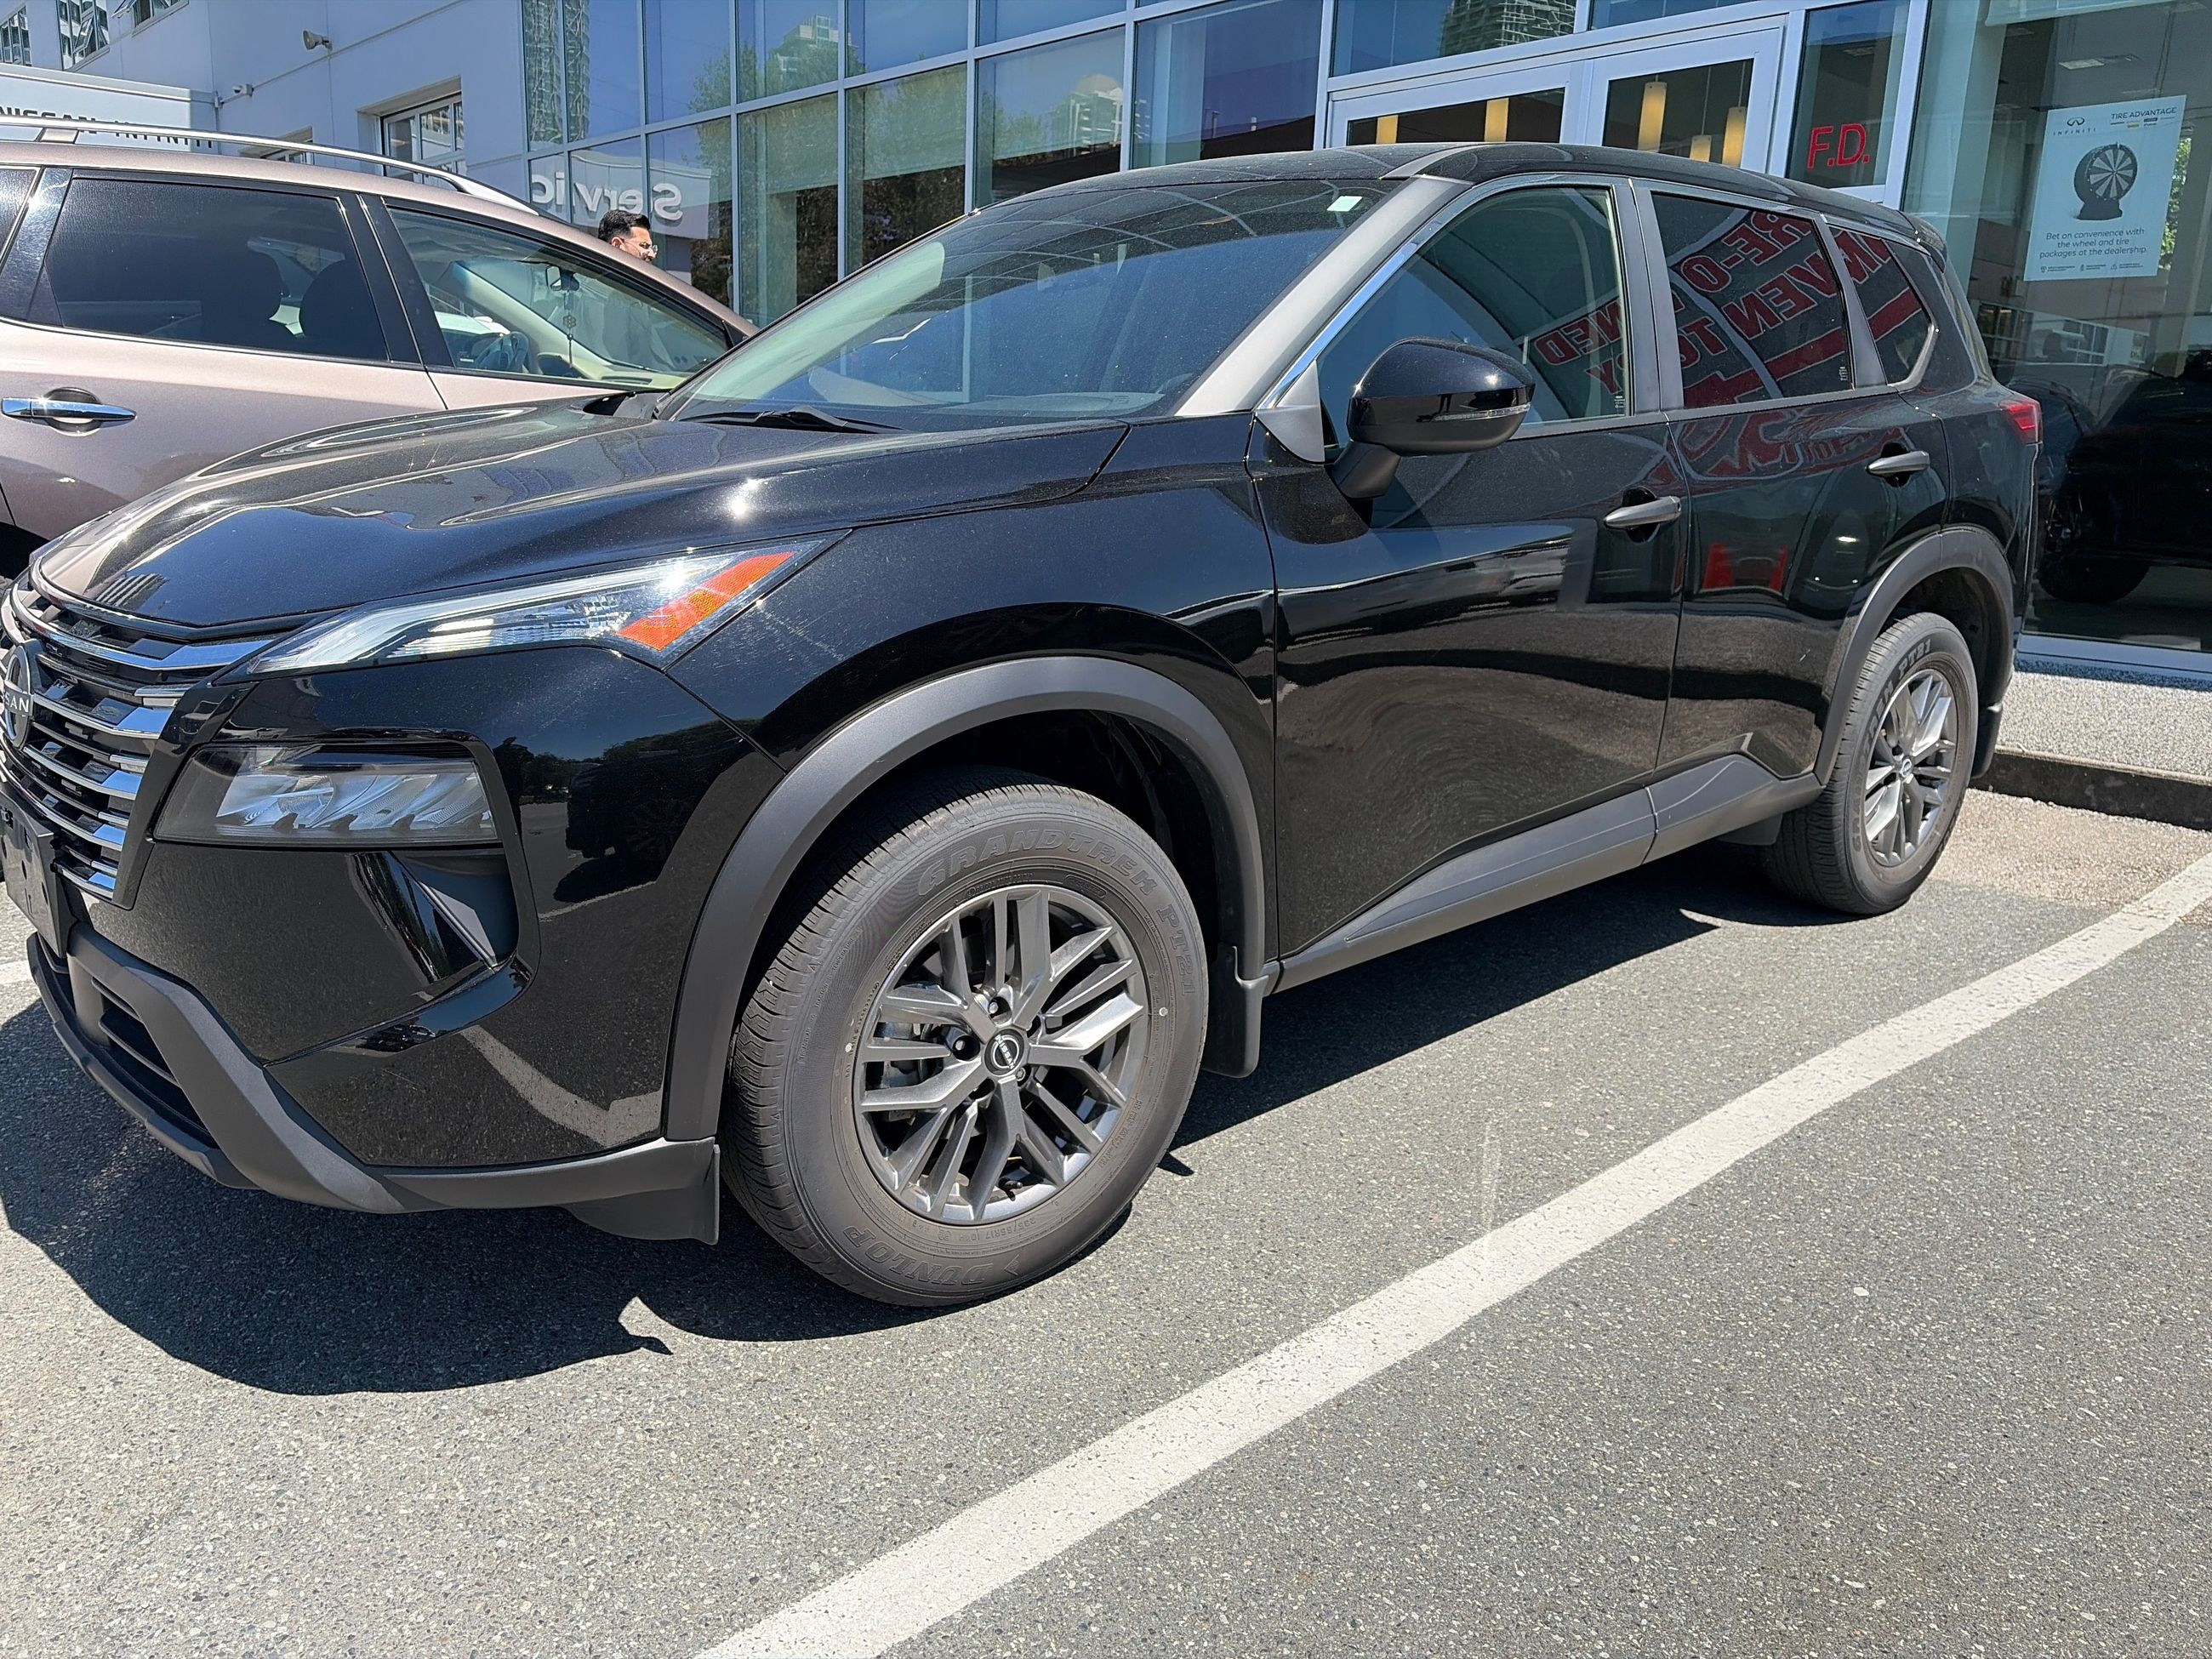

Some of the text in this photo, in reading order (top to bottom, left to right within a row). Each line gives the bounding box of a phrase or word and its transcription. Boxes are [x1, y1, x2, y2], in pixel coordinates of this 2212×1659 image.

[2129, 107, 2177, 118] ADVANTAGE
[2053, 128, 2096, 136] INFINITI
[1807, 123, 1870, 169] F.D.
[2074, 229, 2124, 238] convenience
[2125, 227, 2145, 236] with
[2072, 239, 2097, 248] wheel
[2098, 238, 2114, 247] and
[2116, 237, 2129, 246] tire
[2039, 248, 2077, 259] packages
[918, 829, 1196, 995] GRANDTREK PT21
[994, 1034, 1015, 1069] NISSAN
[843, 1226, 994, 1286] DUNLOP
